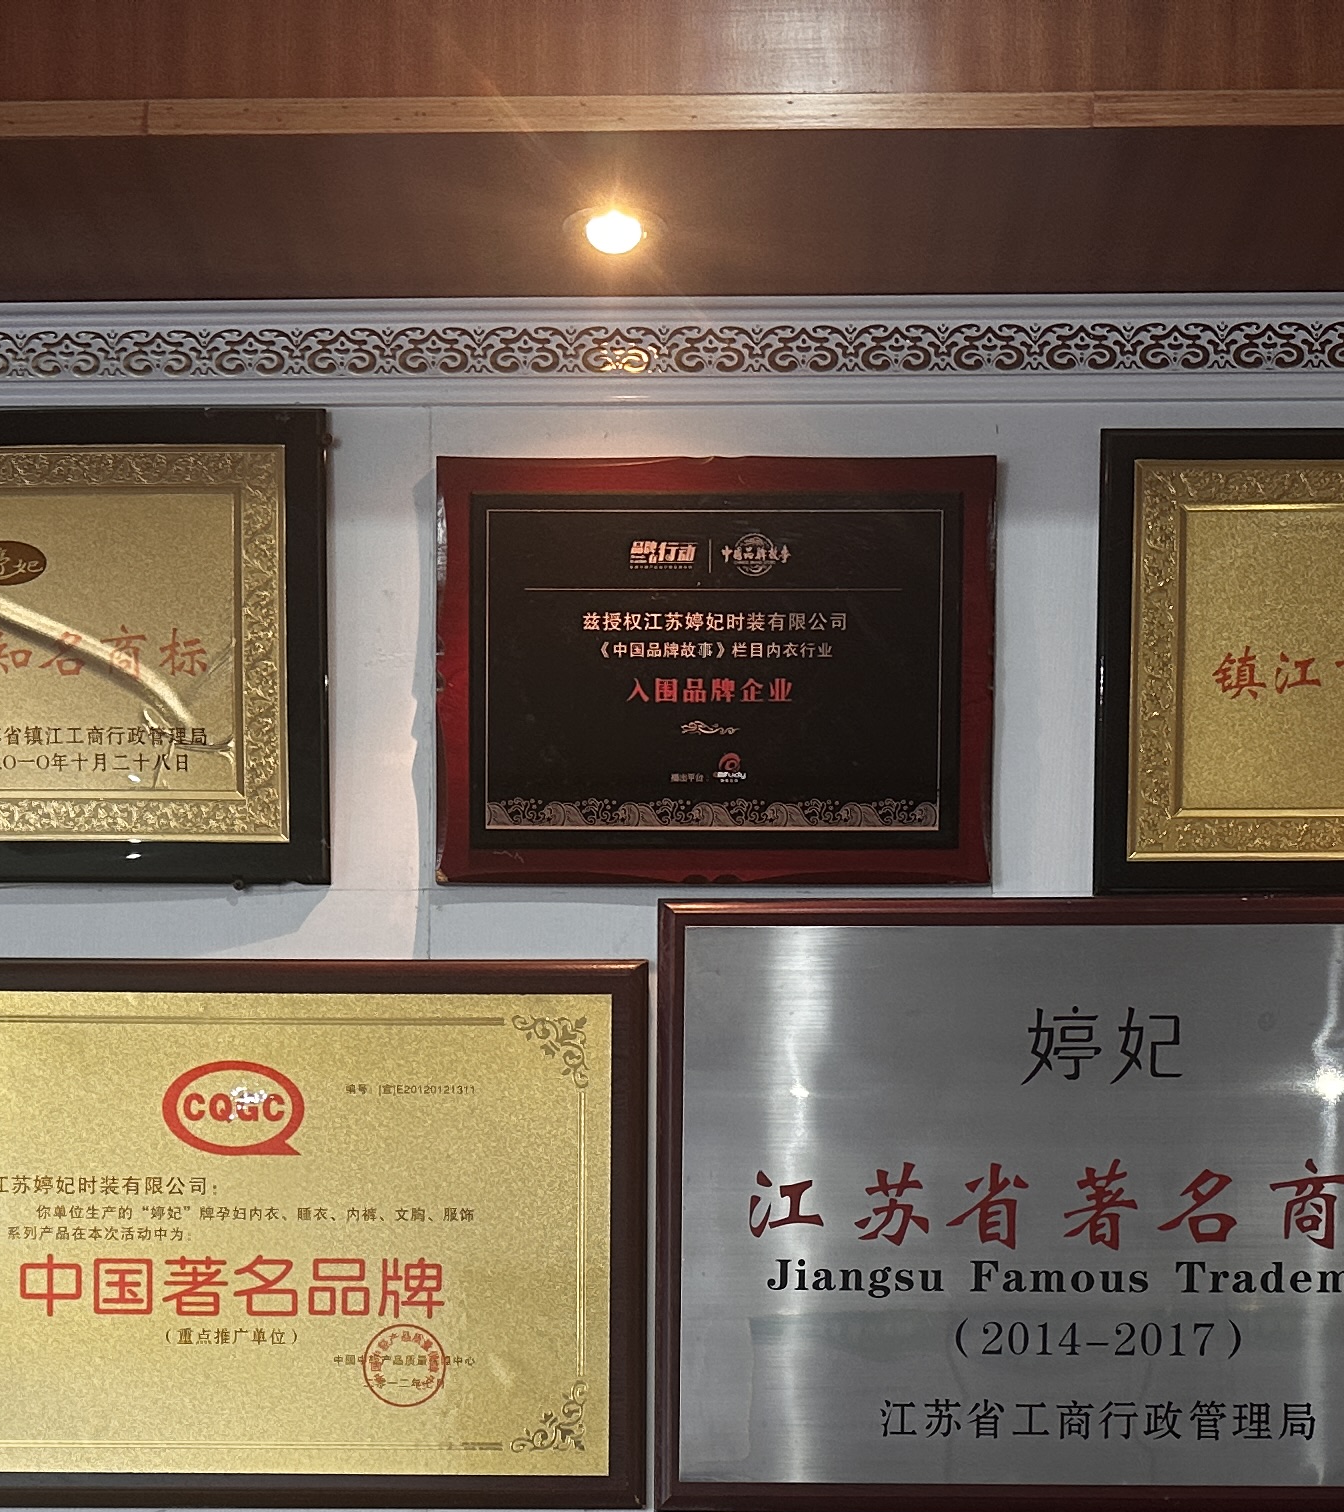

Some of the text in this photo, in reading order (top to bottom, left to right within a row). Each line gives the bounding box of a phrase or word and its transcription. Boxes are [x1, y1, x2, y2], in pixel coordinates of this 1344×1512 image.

[583, 612, 848, 632] 兹授权江苏婷妃时装有限公司
[599, 642, 833, 659] 《中国品牌故事》栏目内衣行业
[627, 678, 793, 703] 入围品牌企业
[1020, 1004, 1183, 1086] 婷妃
[183, 1090, 287, 1124] CQGC
[19, 1253, 446, 1319] 中国著名品牌
[766, 1258, 945, 1296] Jiangsu
[970, 1260, 1150, 1294] Famous
[880, 1399, 1317, 1441] 江苏省工商行政管理局
